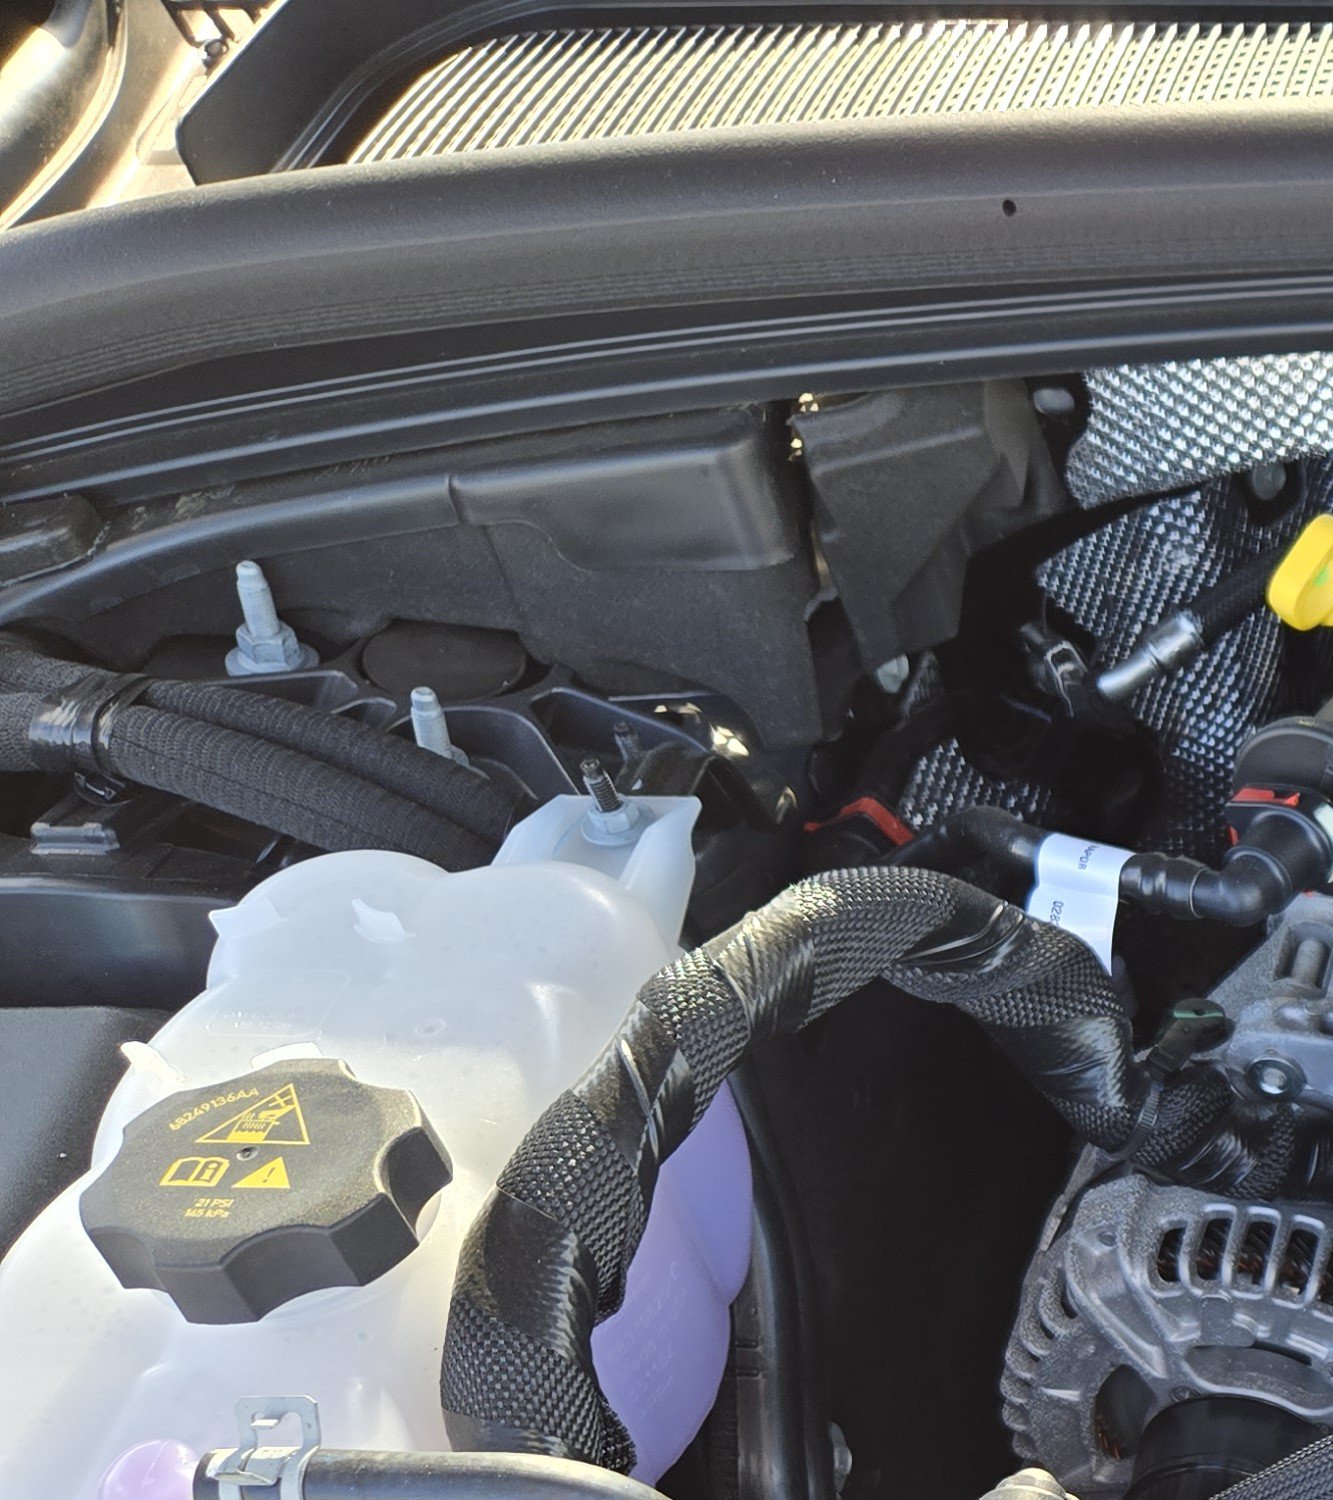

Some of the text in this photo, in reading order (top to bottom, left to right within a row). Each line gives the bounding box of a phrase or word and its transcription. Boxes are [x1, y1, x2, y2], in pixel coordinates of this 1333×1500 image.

[169, 1087, 260, 1131] 68249136AA
[195, 1198, 235, 1208] 21 PSI
[205, 1208, 230, 1218] kPa
